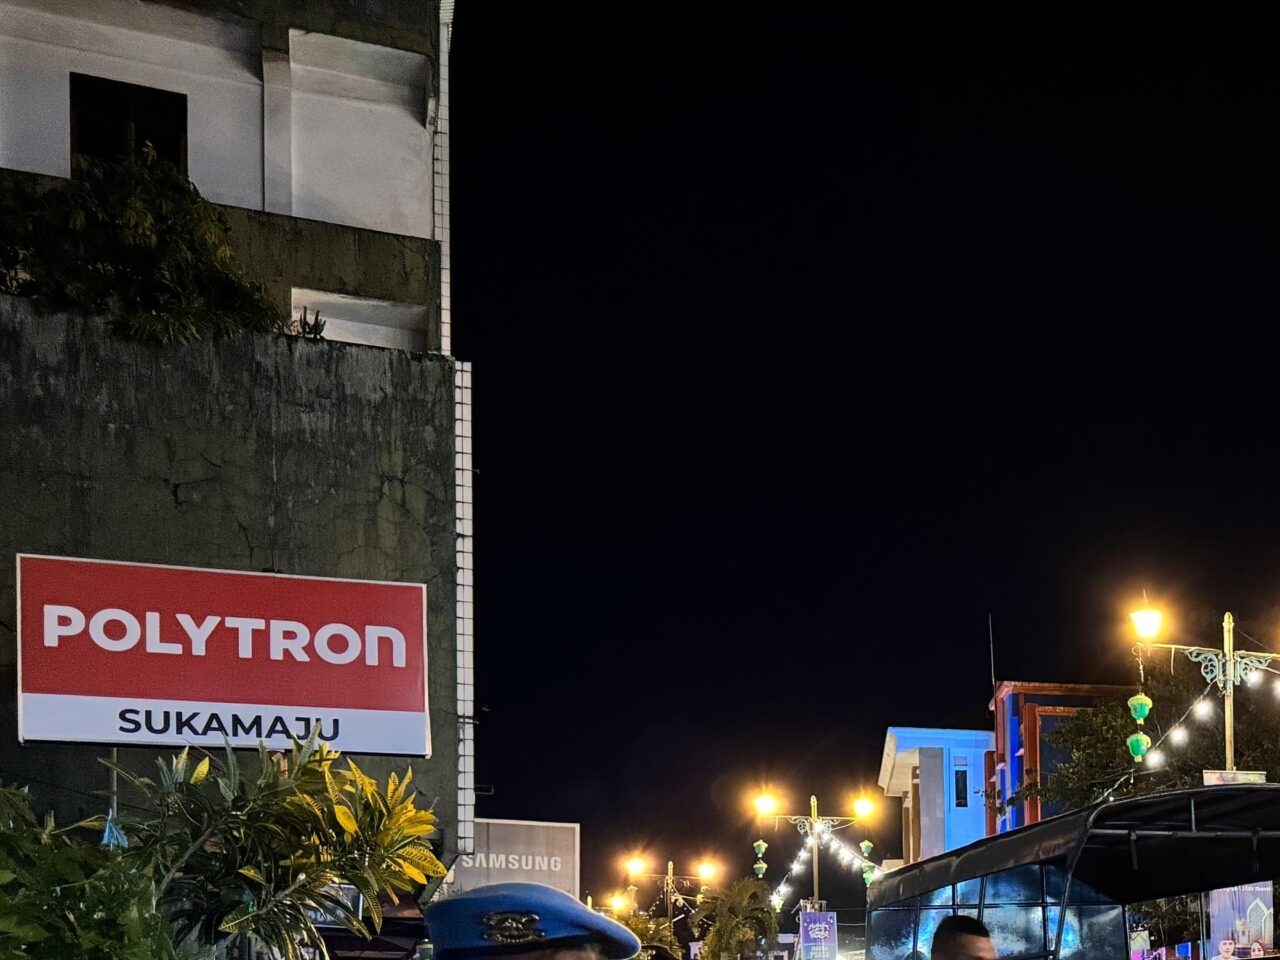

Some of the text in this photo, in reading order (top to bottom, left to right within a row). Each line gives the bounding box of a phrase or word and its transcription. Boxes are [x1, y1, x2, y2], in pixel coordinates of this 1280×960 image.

[43, 604, 407, 668] POLYTRON
[118, 708, 341, 743] SUKAMAJU
[462, 853, 562, 871] SAMSUNG
